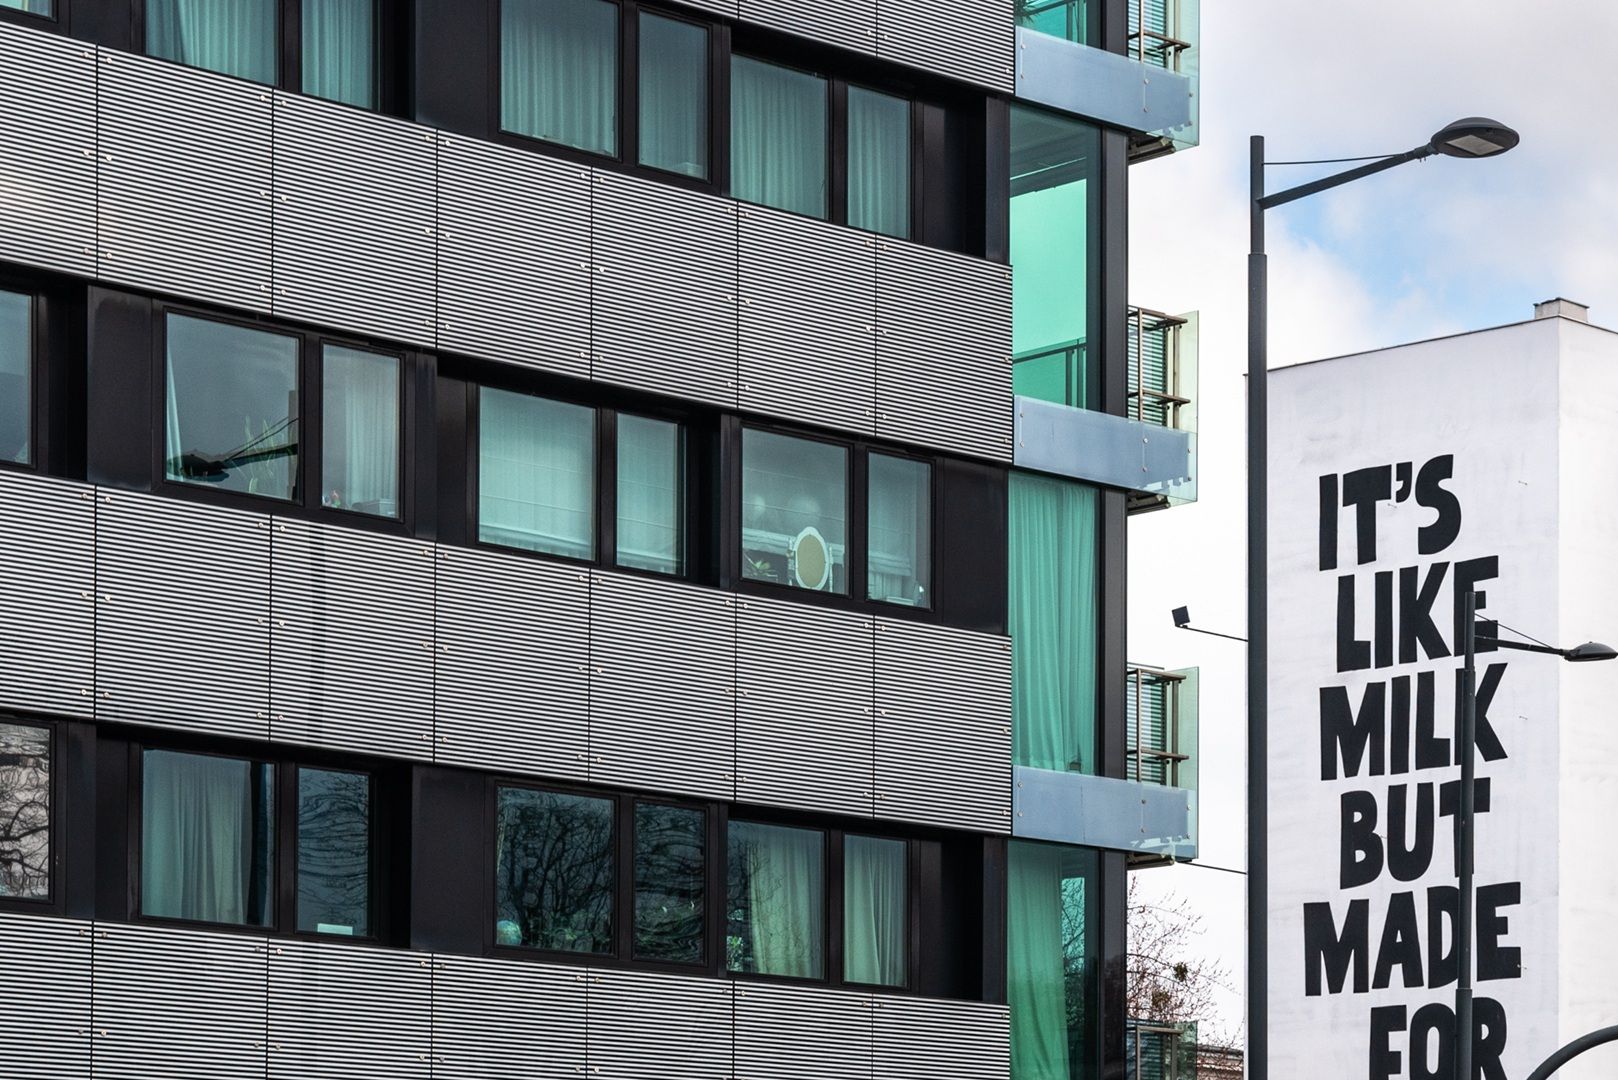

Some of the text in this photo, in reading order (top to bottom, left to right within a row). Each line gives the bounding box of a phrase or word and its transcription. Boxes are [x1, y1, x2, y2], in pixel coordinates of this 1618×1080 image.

[1319, 454, 1462, 571] IT'S
[1337, 555, 1499, 673] LIKE
[1319, 663, 1508, 780] MILK
[1340, 777, 1490, 889] BUT
[1303, 882, 1521, 996] MADE
